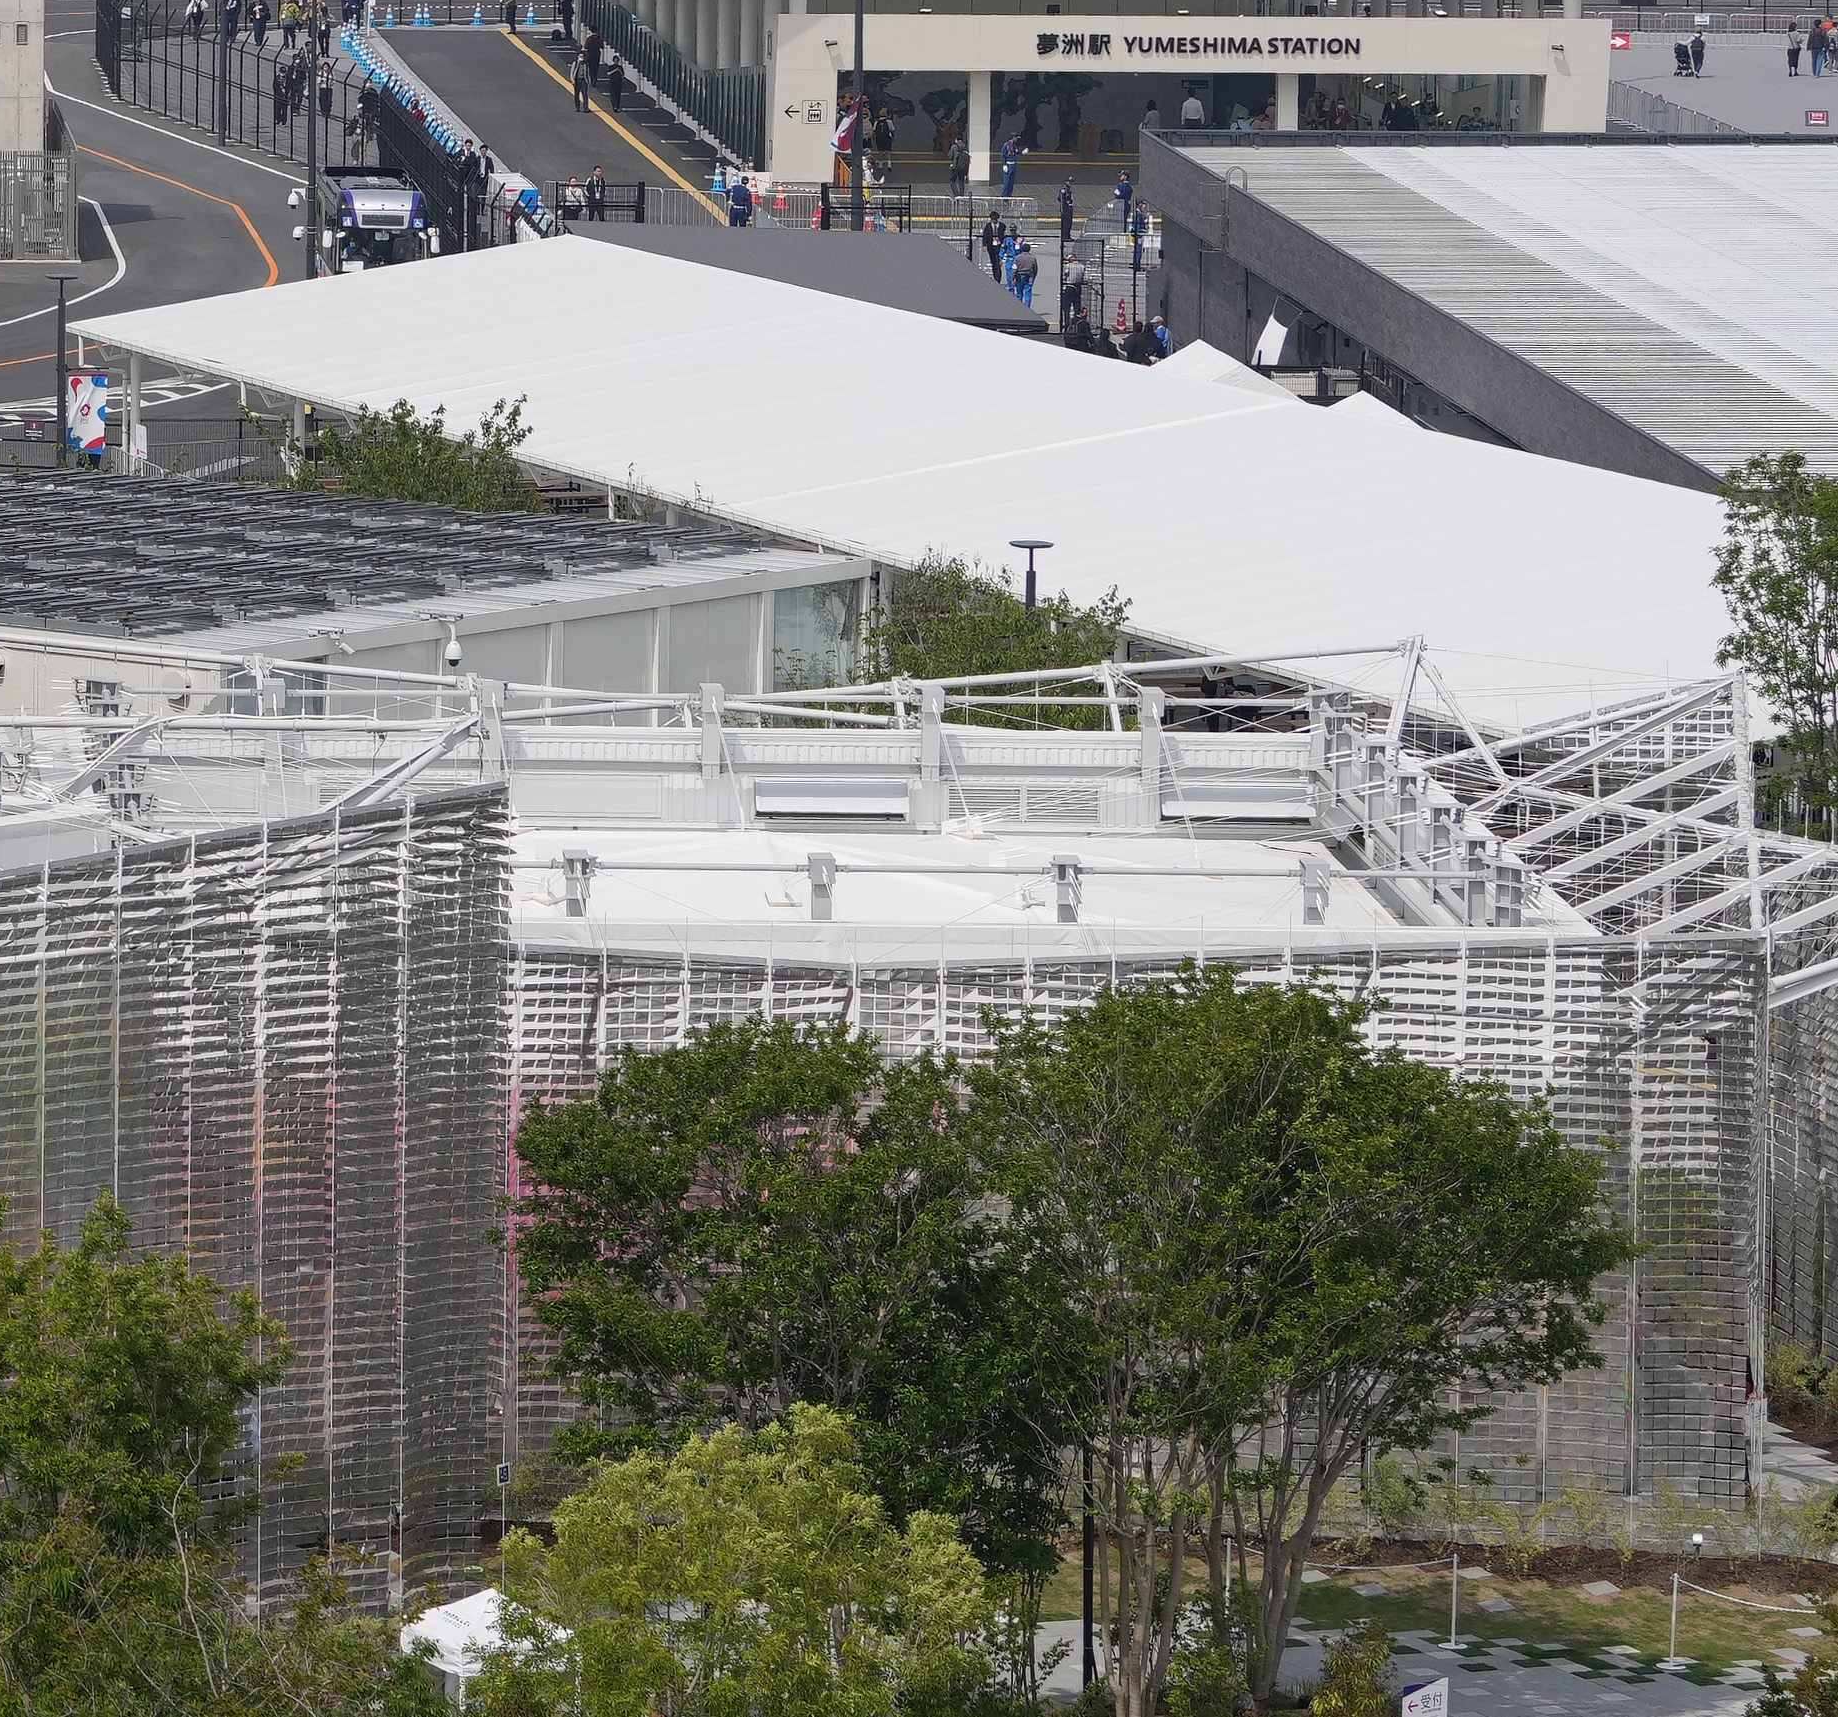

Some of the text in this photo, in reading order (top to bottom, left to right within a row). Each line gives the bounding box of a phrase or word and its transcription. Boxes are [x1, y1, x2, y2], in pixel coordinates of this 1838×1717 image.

[1036, 33, 1361, 55] 夢洲駅 YUMESHIMA STATION
[1420, 1691, 1442, 1710] 受付
